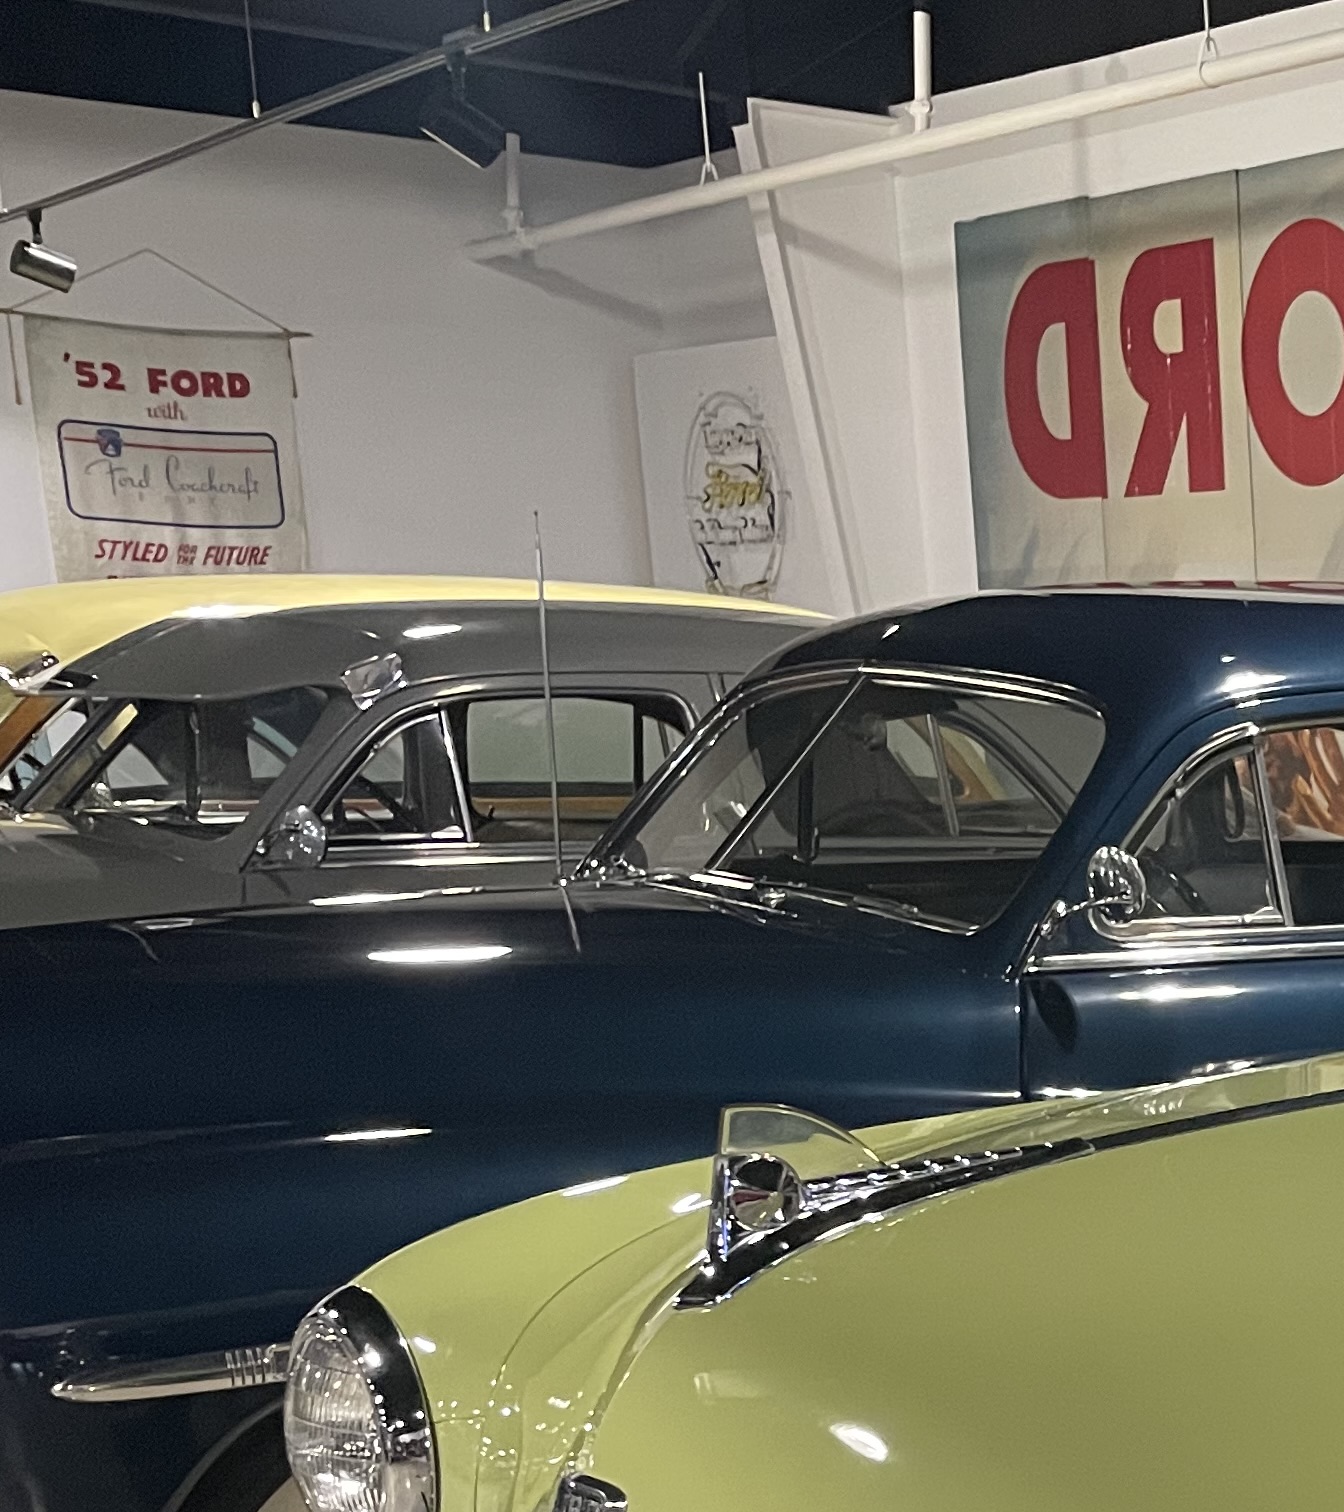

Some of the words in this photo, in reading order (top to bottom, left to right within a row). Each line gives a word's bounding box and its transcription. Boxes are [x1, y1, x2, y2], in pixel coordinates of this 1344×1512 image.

[63, 352, 126, 391] '52
[146, 367, 251, 398] FORD
[146, 401, 188, 421] with
[84, 457, 150, 496] Ford
[165, 454, 259, 501] Coachcraft
[94, 539, 169, 564] STYLED
[203, 545, 272, 566] FUTURE
